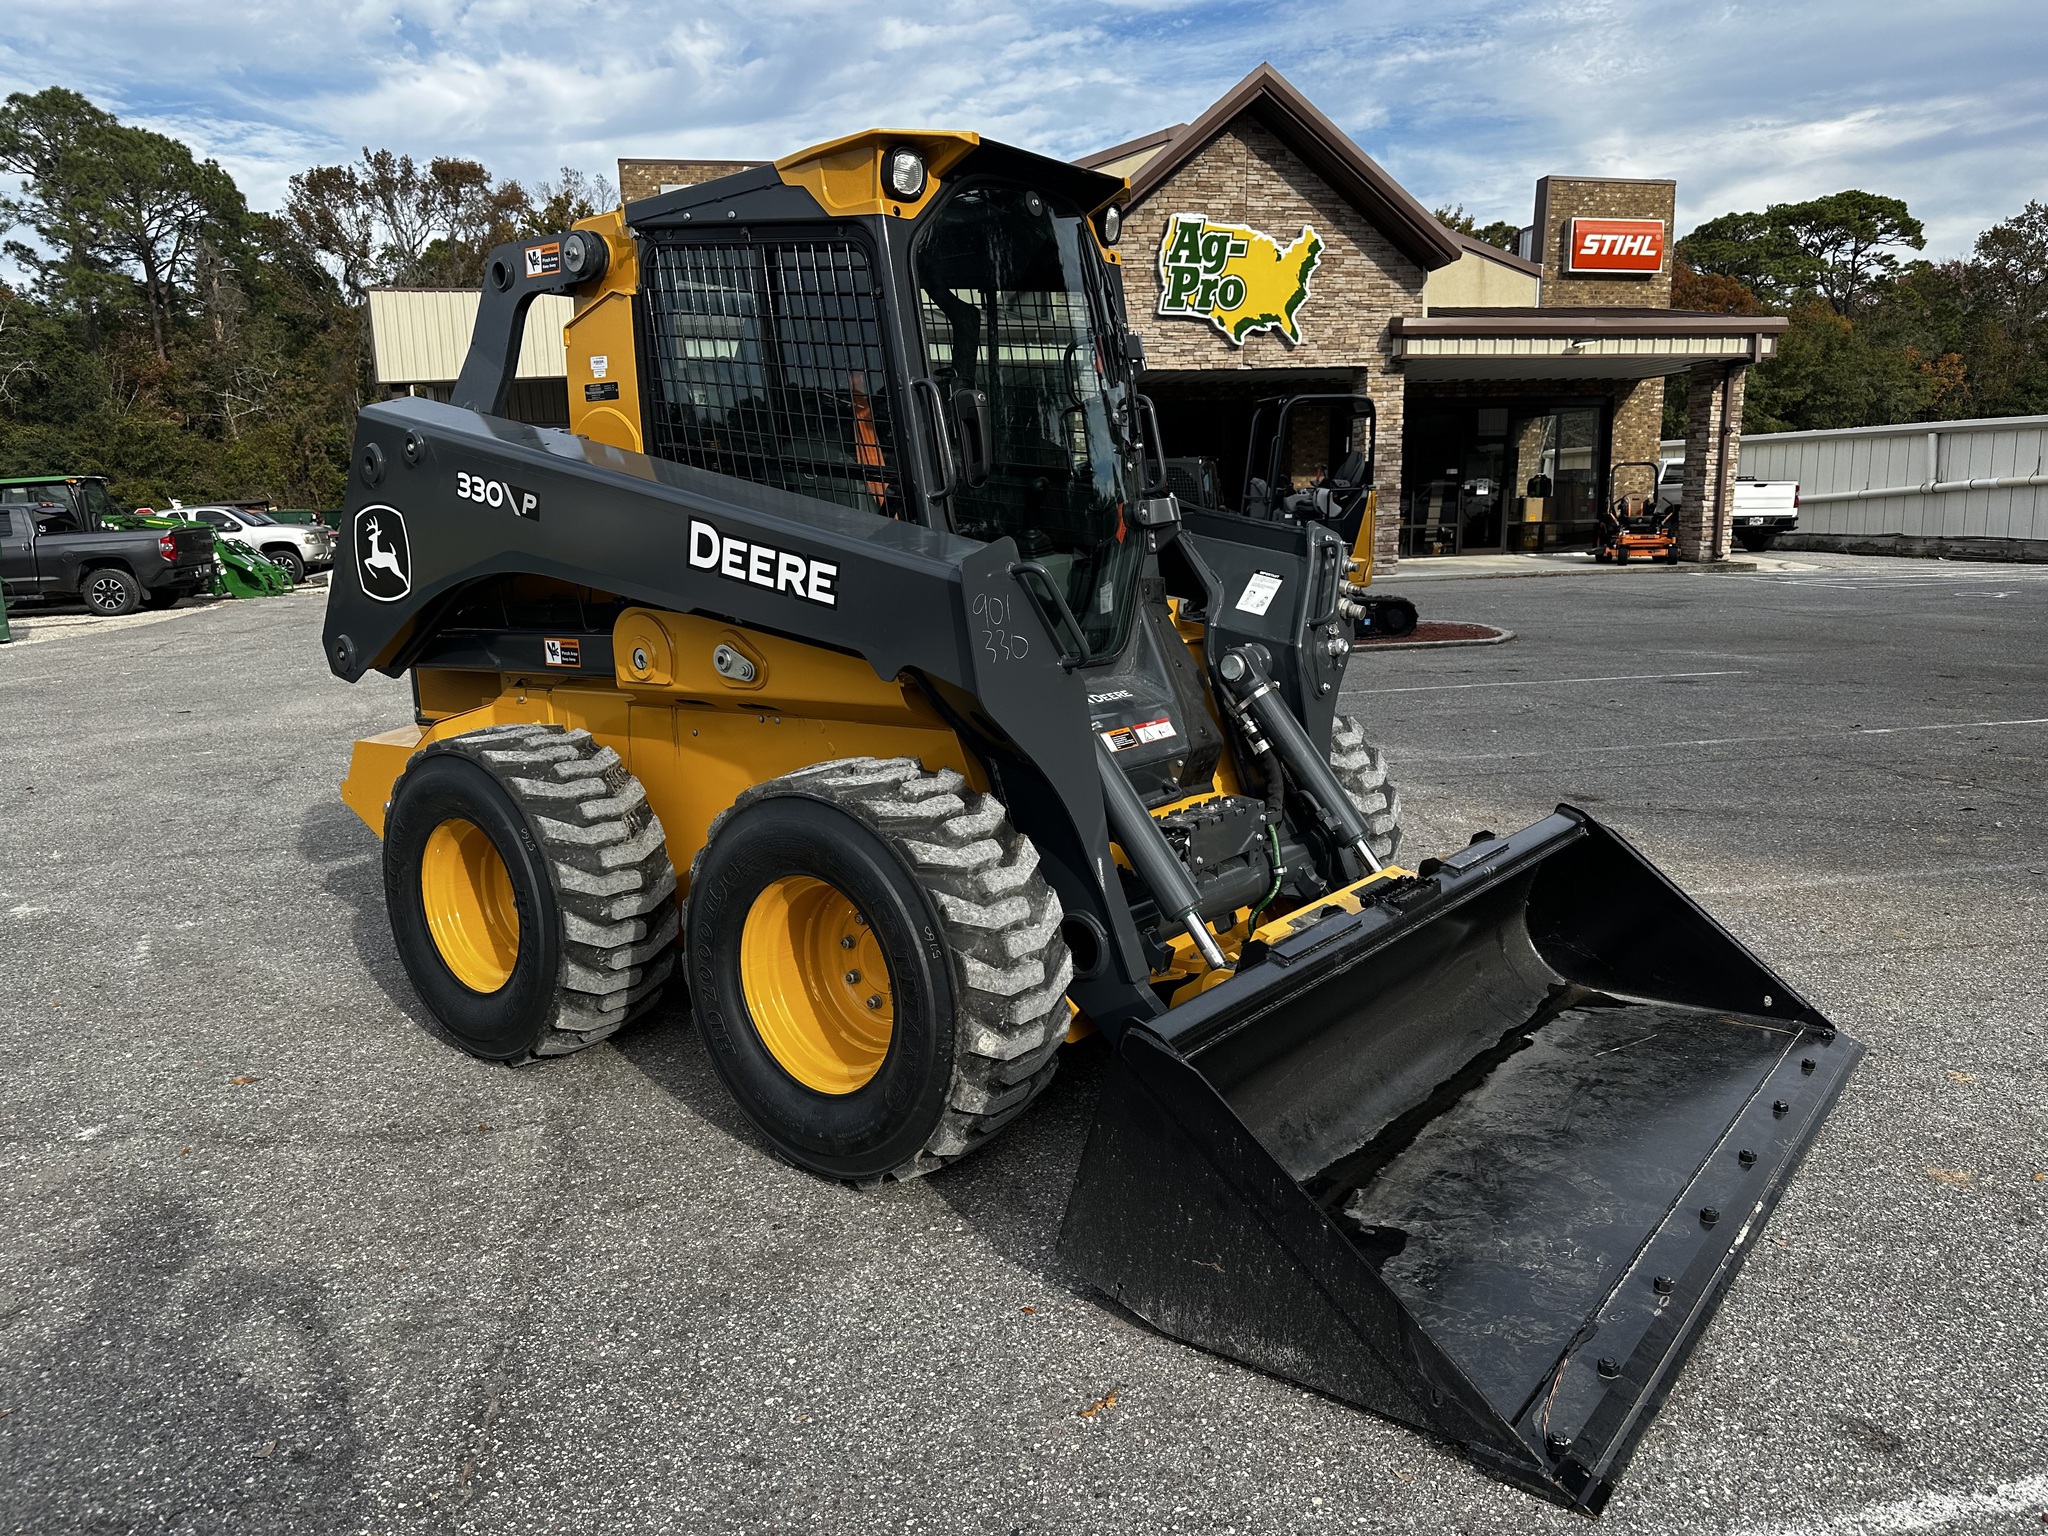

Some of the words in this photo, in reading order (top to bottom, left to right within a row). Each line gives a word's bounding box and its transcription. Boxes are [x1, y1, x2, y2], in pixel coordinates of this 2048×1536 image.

[1168, 221, 1246, 275] Ag-
[1579, 234, 1657, 256] STIHL
[1166, 265, 1244, 308] Pro
[689, 520, 838, 606] DEERE
[972, 593, 1011, 630] 901
[981, 629, 1029, 664] 330
[1089, 690, 1133, 703] DEERE
